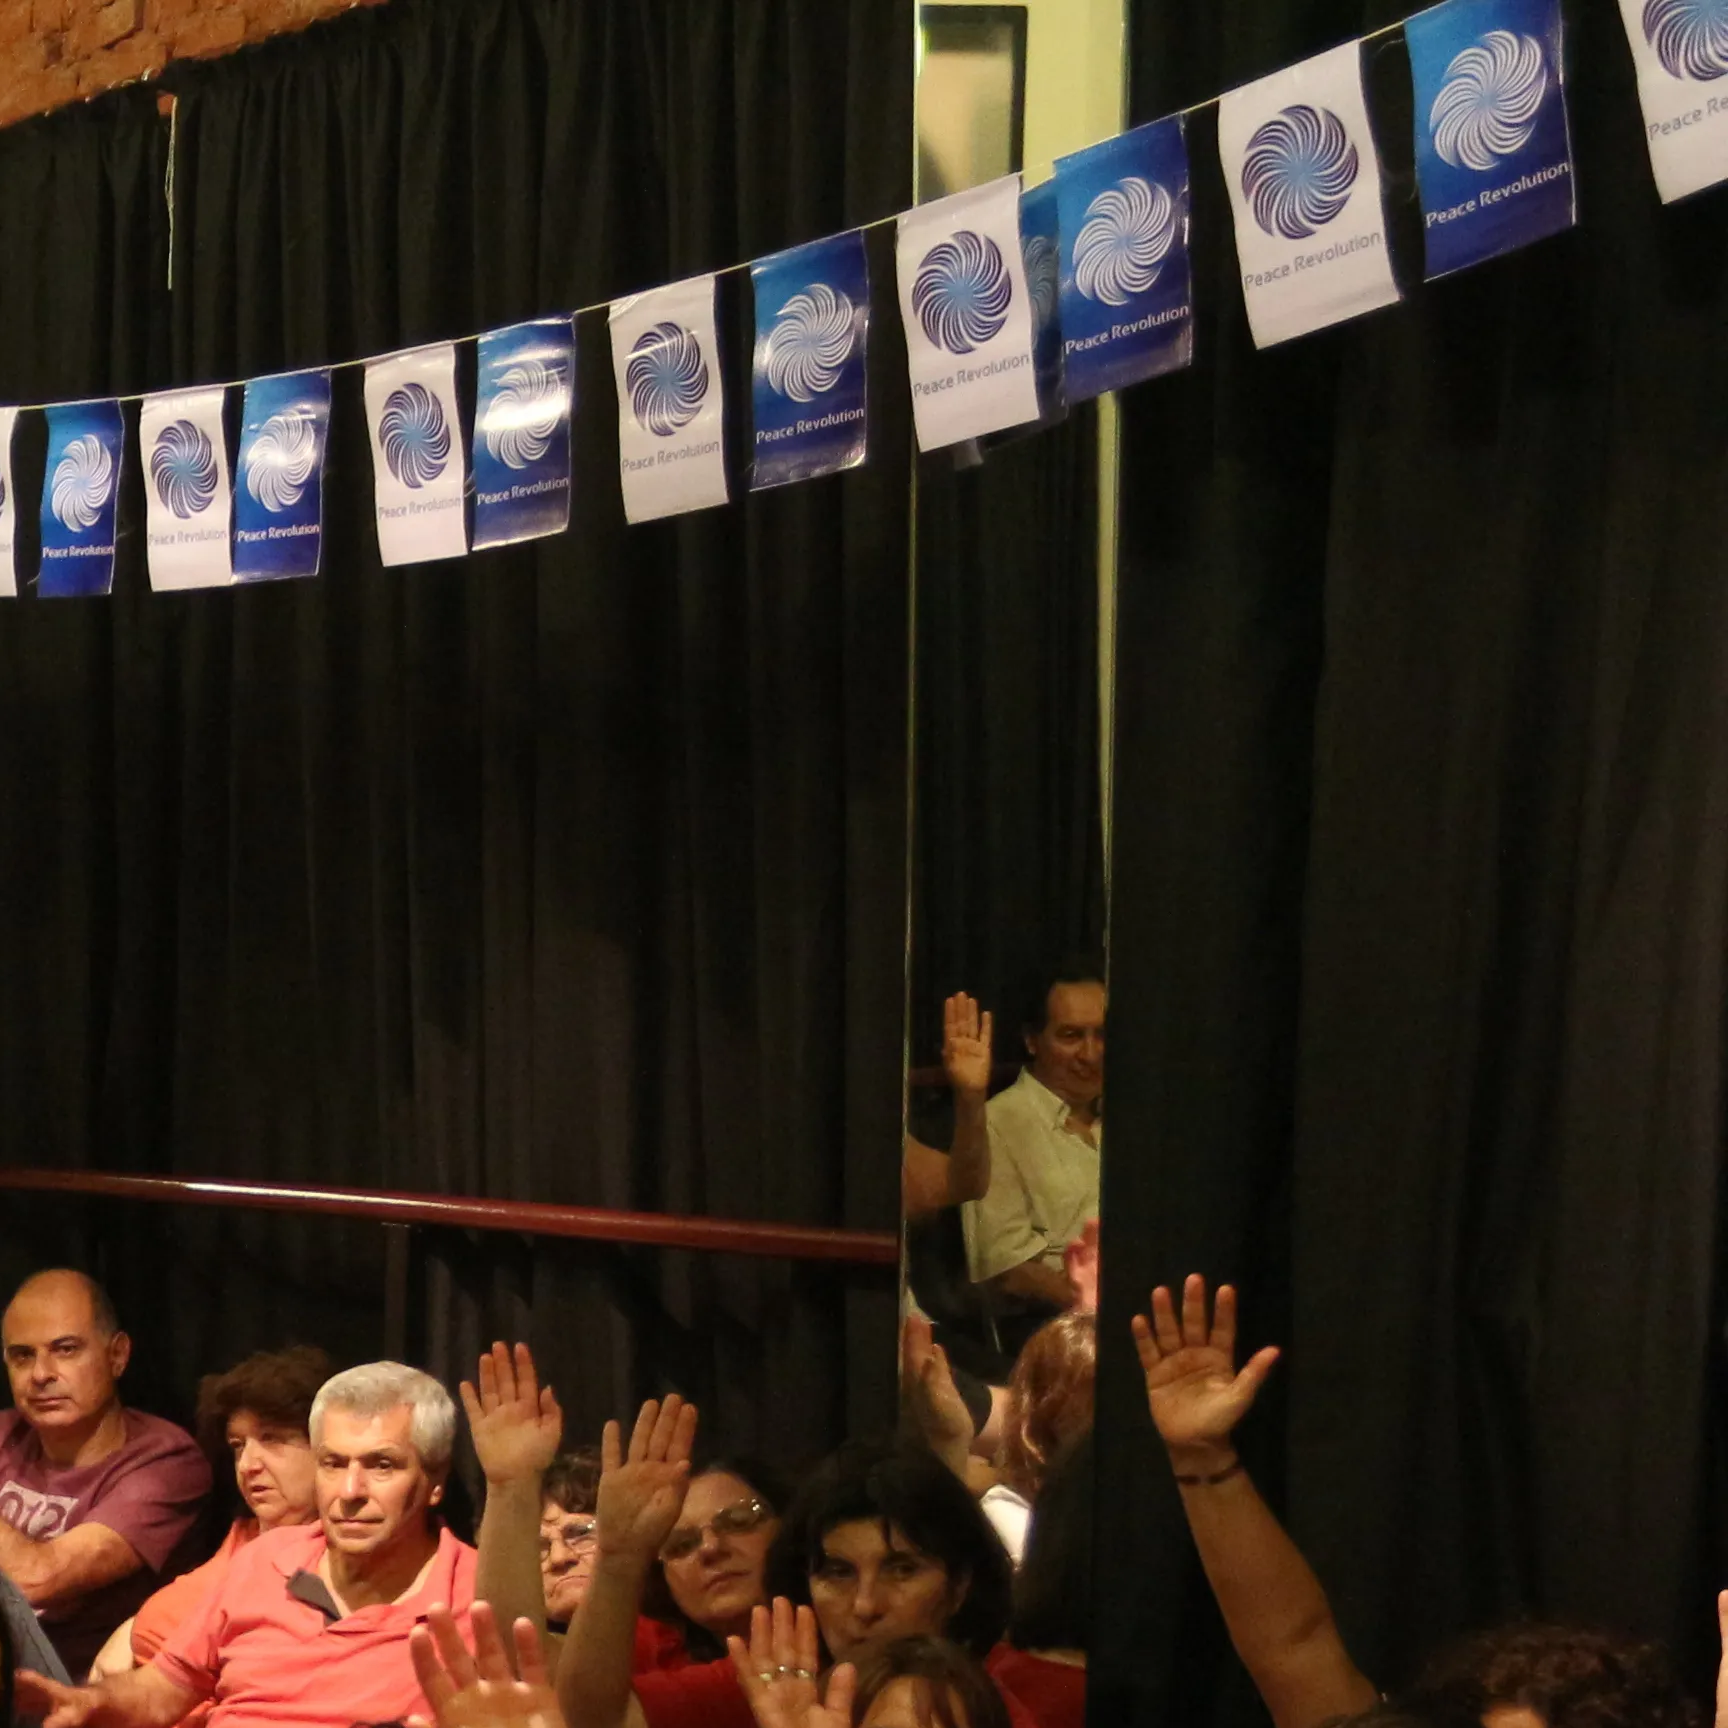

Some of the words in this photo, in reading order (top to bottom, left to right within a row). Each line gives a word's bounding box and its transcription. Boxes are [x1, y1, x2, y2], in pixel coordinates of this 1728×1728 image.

[1648, 107, 1703, 141] Peace
[1425, 201, 1477, 228] Peace
[1480, 161, 1571, 207] Revolution
[1244, 263, 1291, 290] Peace
[1294, 231, 1382, 272] Revolution
[1065, 333, 1110, 355] Peace
[1111, 305, 1189, 339] Revolution
[913, 374, 955, 398] Peace
[956, 354, 1031, 385] Revolution
[755, 426, 795, 444] Peace
[796, 408, 865, 434] Revolution
[621, 456, 655, 474] Peace
[656, 440, 721, 463] Revolution
[378, 505, 407, 519] Peace
[408, 496, 462, 514] Revolution
[477, 490, 510, 506] Peace
[511, 477, 570, 498] Revolution
[148, 532, 175, 546] Peace
[176, 528, 228, 544] Revolution
[236, 529, 267, 543] Peace
[268, 523, 321, 539] Revolution
[42, 547, 68, 559] Peace
[69, 544, 116, 558] Revolution
